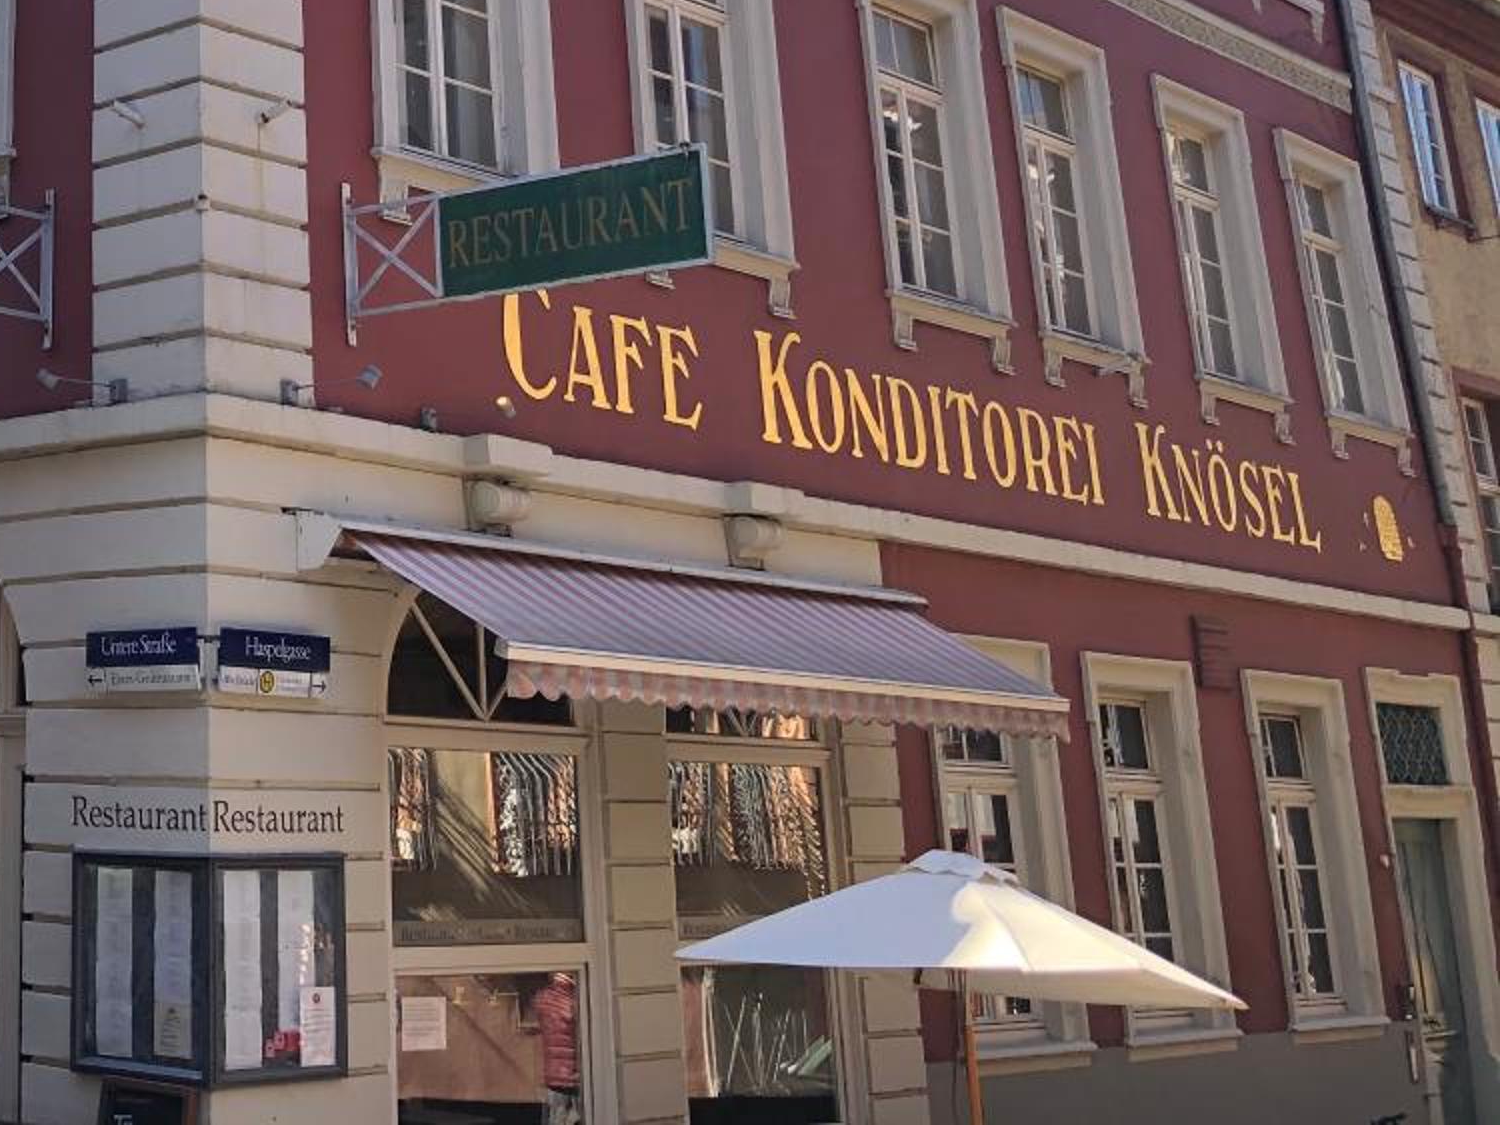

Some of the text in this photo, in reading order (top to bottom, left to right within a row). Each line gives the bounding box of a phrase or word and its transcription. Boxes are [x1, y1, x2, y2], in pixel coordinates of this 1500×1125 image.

[449, 178, 693, 268] RESTAURANT
[502, 288, 1322, 552] CAFE KONDITOREI KNÖSEL
[101, 631, 177, 656] Untere Straße
[245, 634, 312, 664] Haspelgasse
[71, 795, 207, 832] Restaurant
[213, 800, 344, 833] Restaurant
